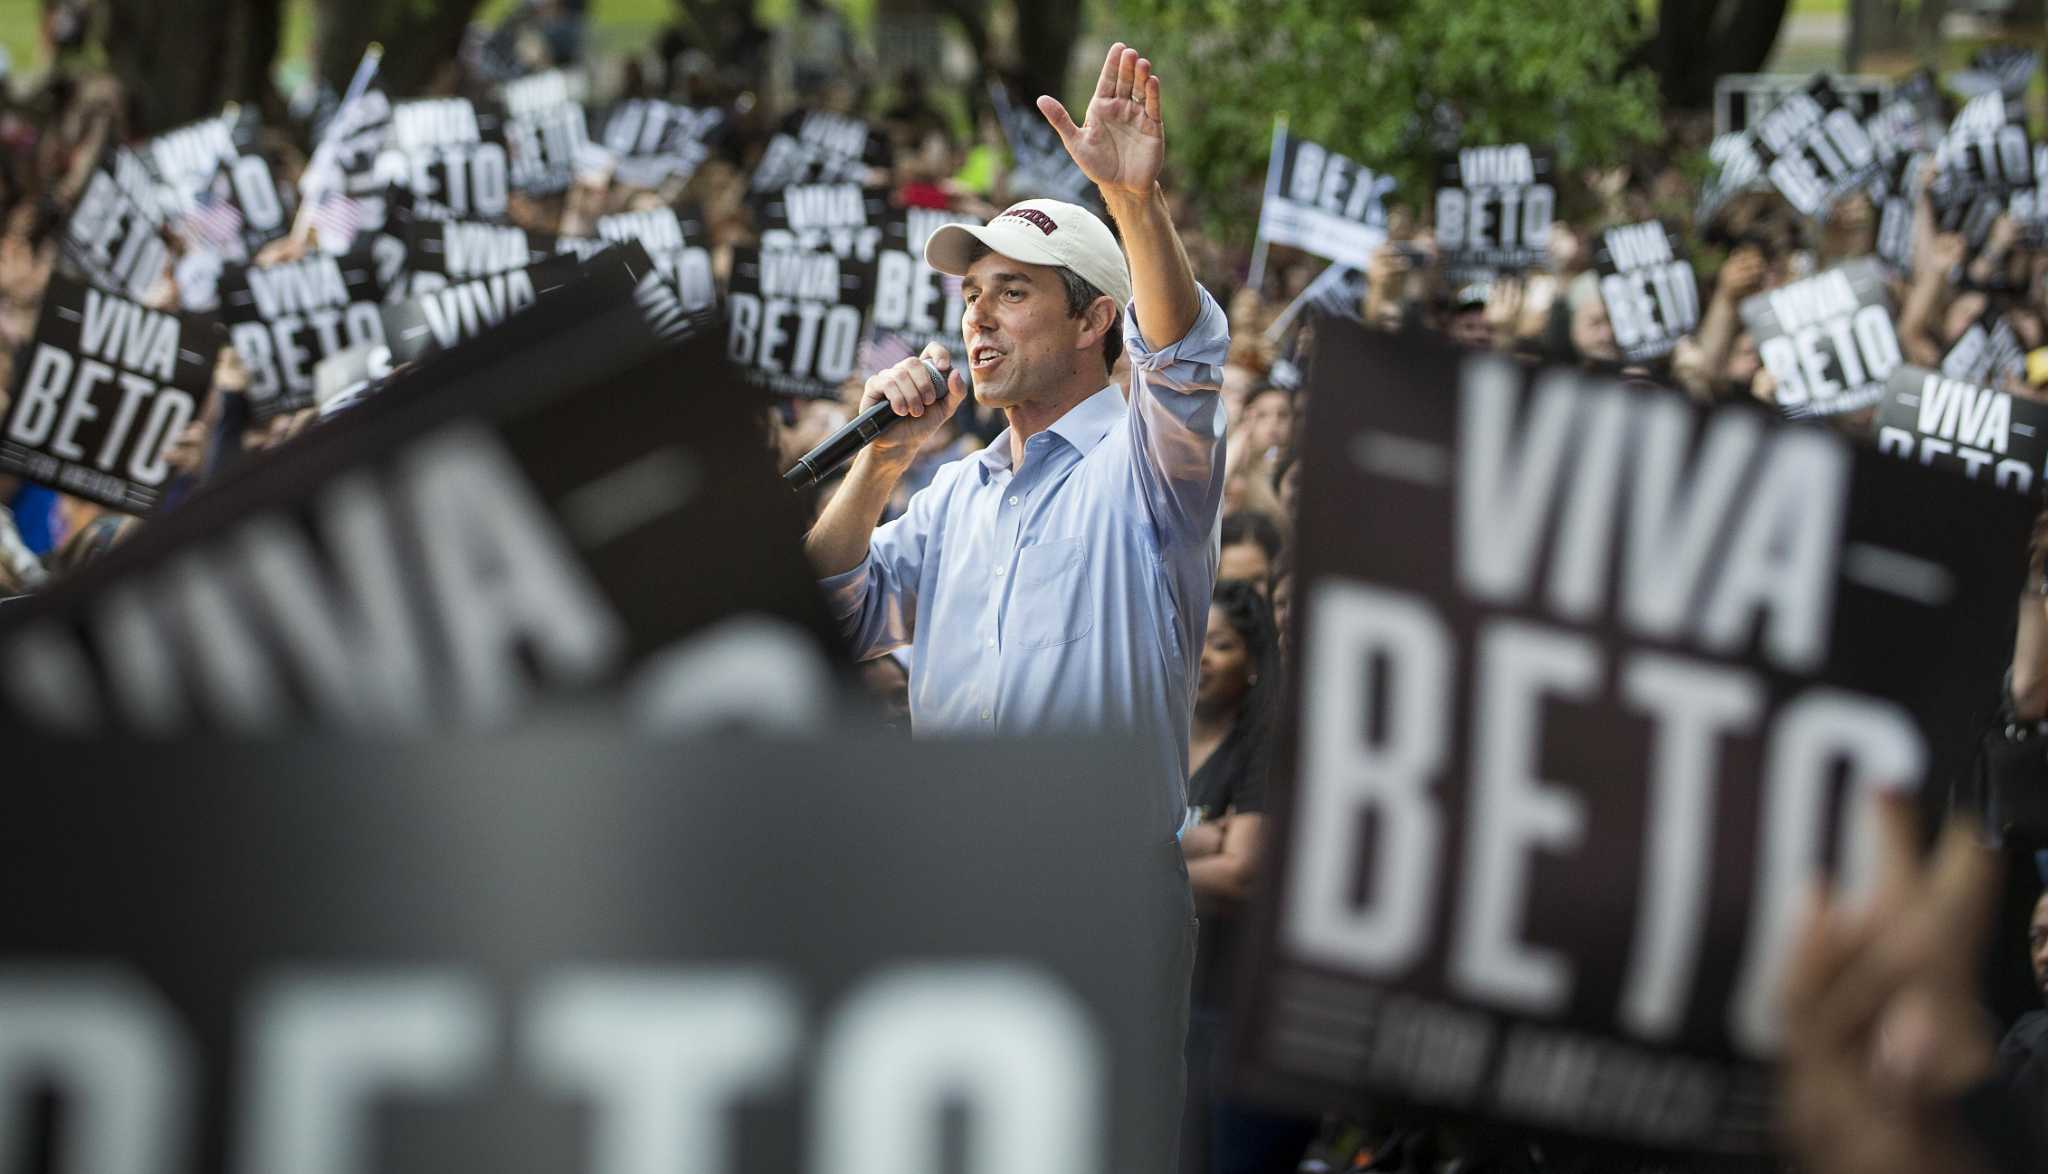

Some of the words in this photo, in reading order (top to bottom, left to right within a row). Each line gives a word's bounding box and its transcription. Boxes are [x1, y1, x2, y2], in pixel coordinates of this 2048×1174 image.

[1435, 183, 1556, 250] BETO
[81, 288, 181, 382] VIVA
[250, 258, 348, 319] VIVA
[728, 293, 862, 384] BETO
[1760, 303, 1902, 406] BETO
[7, 342, 195, 486] BETO
[1917, 373, 2012, 455] VIVA
[1453, 352, 1852, 675] VIVA
[1282, 578, 1930, 1060] BETO
